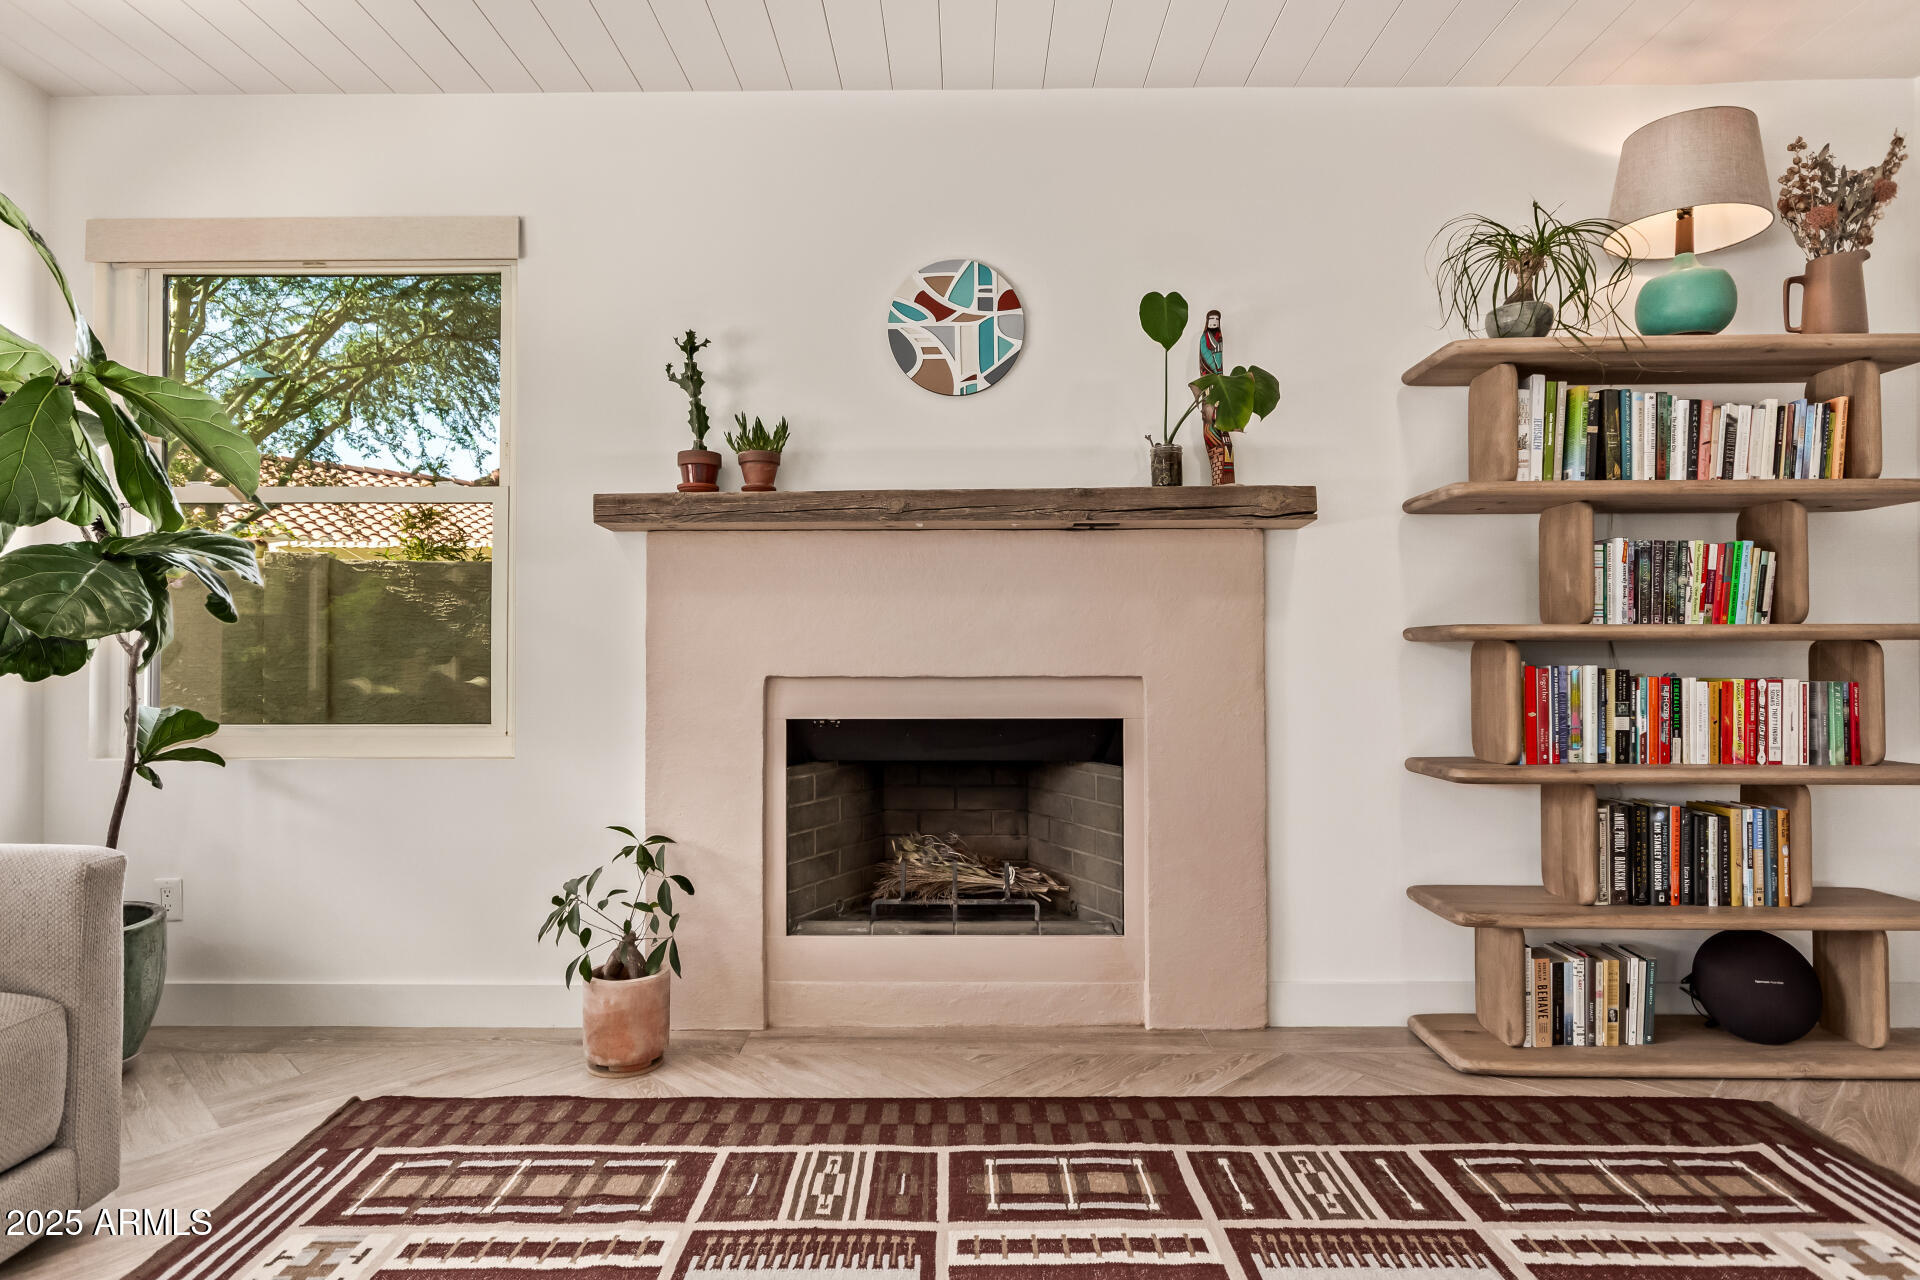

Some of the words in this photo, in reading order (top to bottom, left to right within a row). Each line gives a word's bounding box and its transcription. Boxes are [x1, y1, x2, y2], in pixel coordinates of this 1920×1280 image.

[1533, 418, 1543, 450] JERUSALEM
[1725, 426, 1736, 463] MIDDLESEX
[1540, 672, 1549, 703] Together
[1614, 812, 1625, 830] ANNIE
[1654, 822, 1662, 833] KIM
[1614, 831, 1625, 853] PROULX
[1654, 834, 1662, 860] STANLEY
[1614, 856, 1626, 891] BARKSKINS
[1654, 860, 1662, 890] ROBINSON
[1537, 984, 1549, 1020] BEHAVE
